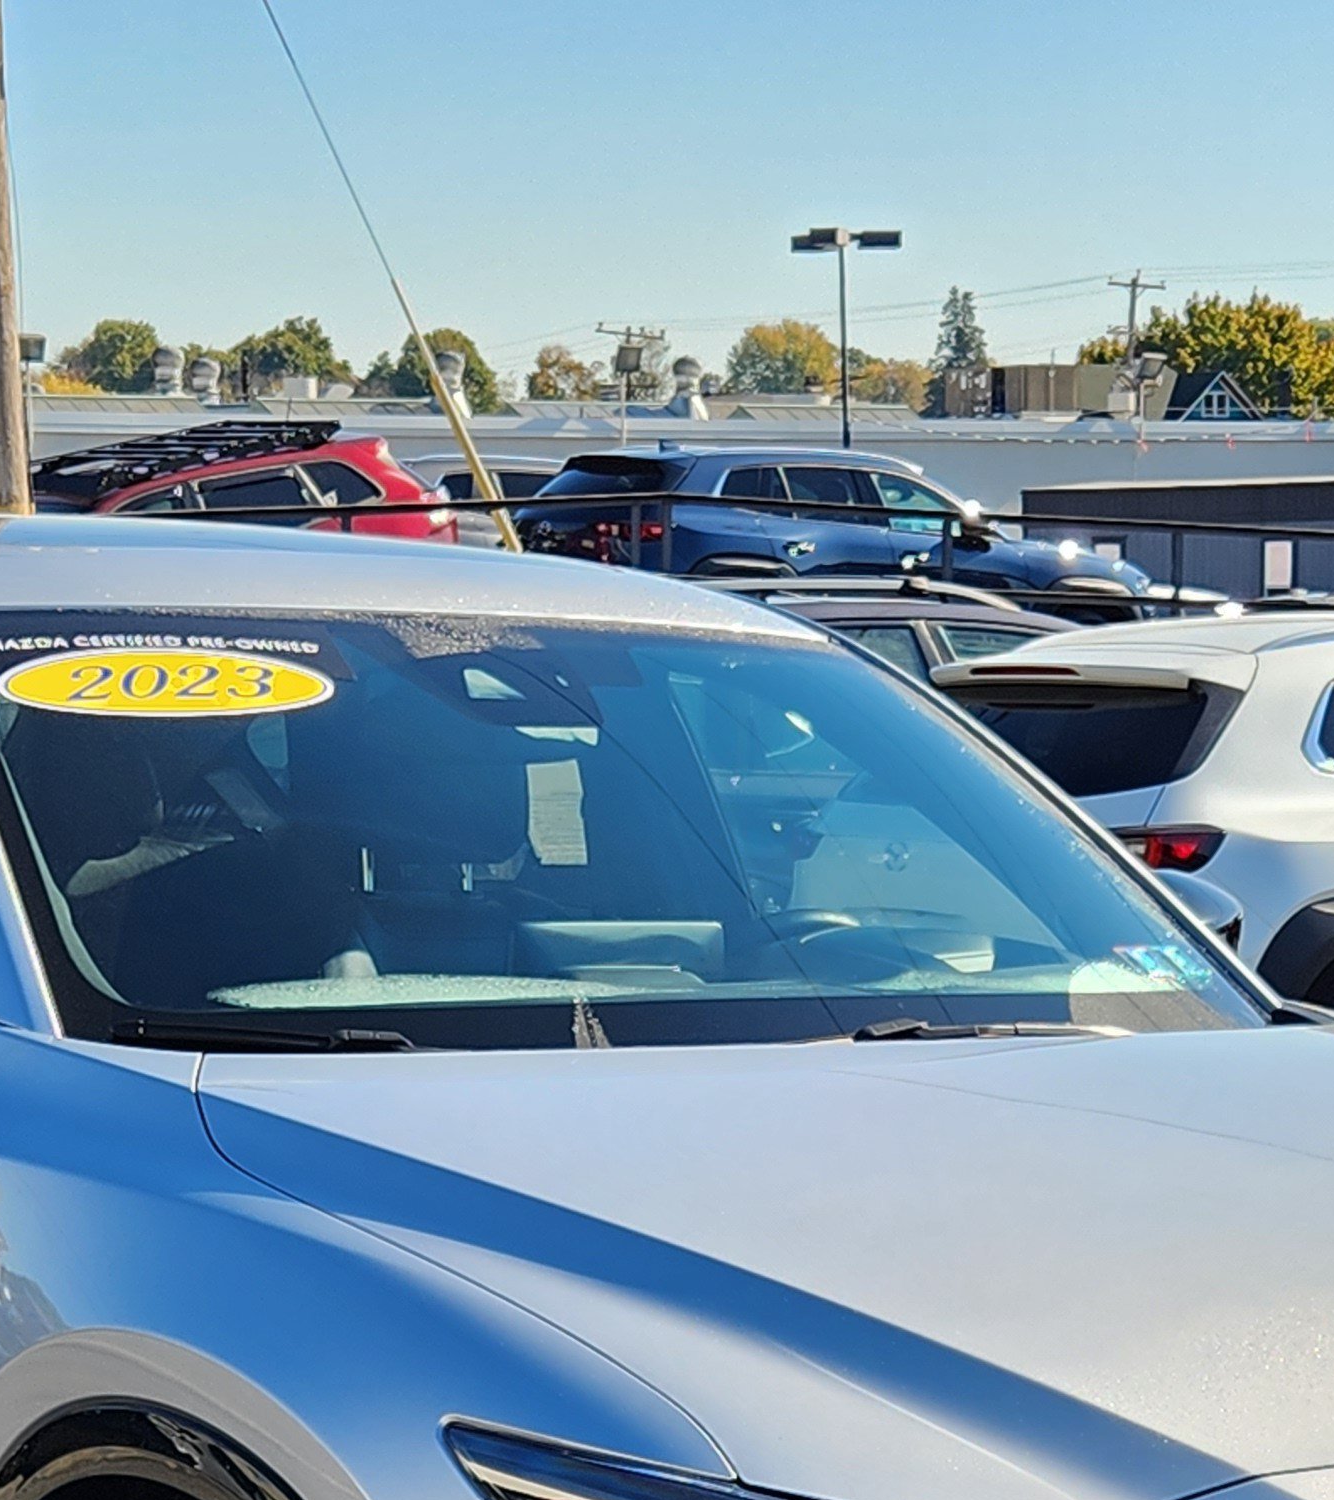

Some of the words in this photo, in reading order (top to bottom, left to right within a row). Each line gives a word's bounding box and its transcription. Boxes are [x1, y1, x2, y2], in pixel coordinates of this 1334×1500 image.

[73, 634, 182, 648] CERTIFIED
[187, 635, 319, 654] PRE-OWNED
[66, 664, 275, 702] 2023
